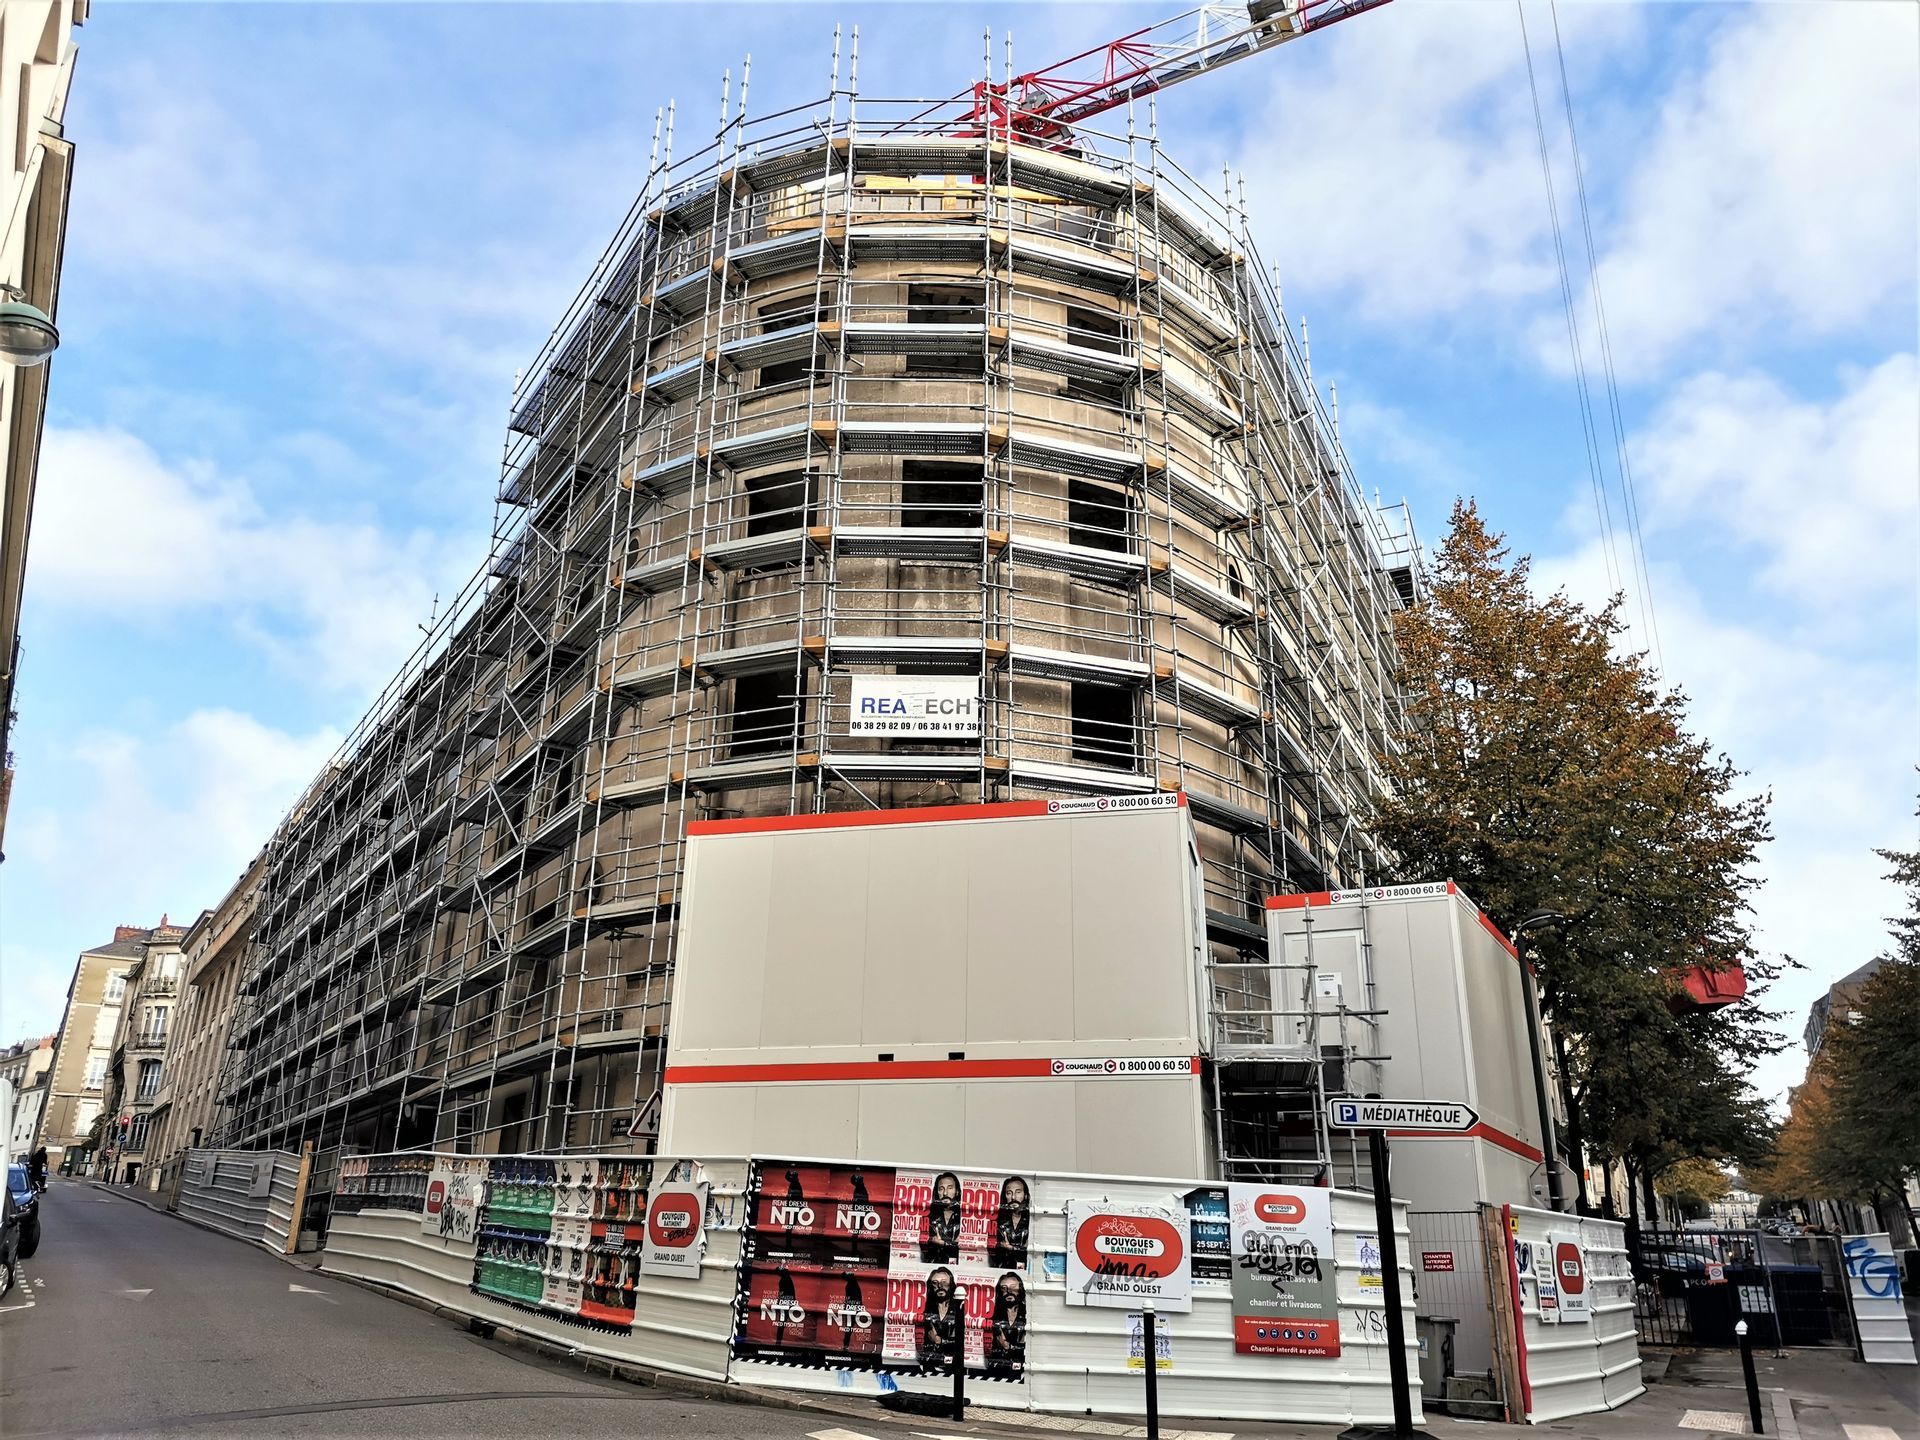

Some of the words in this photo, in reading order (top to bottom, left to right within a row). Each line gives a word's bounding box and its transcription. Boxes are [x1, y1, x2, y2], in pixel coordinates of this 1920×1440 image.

[852, 722, 861, 730] 06
[864, 722, 874, 730] 38
[876, 722, 886, 730] 29
[888, 722, 898, 730] 82
[900, 722, 911, 731] 09
[918, 723, 928, 731] 06
[930, 723, 940, 731] 38
[943, 723, 952, 731] 41
[955, 723, 965, 731] 97
[967, 723, 977, 731] 38
[1111, 799, 1117, 808] 0
[1118, 798, 1136, 807] 800
[1137, 797, 1149, 806] 00
[1151, 796, 1163, 805] 60
[1165, 795, 1177, 804] 50
[1386, 889, 1392, 897] 0
[1393, 888, 1409, 896] 800
[1410, 887, 1421, 895] 00
[1423, 885, 1434, 893] 60
[1435, 884, 1446, 893] 50
[1119, 1061, 1126, 1071] 0
[1128, 1060, 1147, 1071] 800
[1148, 1060, 1161, 1070] 00
[1163, 1060, 1175, 1070] 60
[1178, 1060, 1190, 1070] 50
[1342, 1106, 1353, 1121] P
[1362, 1105, 1461, 1123] MÉDIATHÈQUE
[894, 1185, 932, 1216] BOB
[961, 1189, 1000, 1220] BOB
[661, 1212, 685, 1221] BOUYGUES
[770, 1206, 815, 1226] NTO
[836, 1210, 881, 1231] NTO
[894, 1215, 929, 1232] SINCLAR
[961, 1218, 998, 1236] SINCLAR
[1105, 1237, 1154, 1248] BOUYGUES
[1111, 1246, 1148, 1254] BATIMENT
[654, 1252, 670, 1261] GRAND
[671, 1254, 685, 1262] OUEST
[1097, 1282, 1130, 1292] GRAND
[1133, 1284, 1161, 1294] OUEST
[887, 1279, 926, 1313] BOB
[1249, 1298, 1278, 1307] chantier
[1289, 1300, 1322, 1309] livraisons
[760, 1304, 805, 1323] NTO
[827, 1308, 873, 1329] NTO
[1308, 1347, 1326, 1355] public
